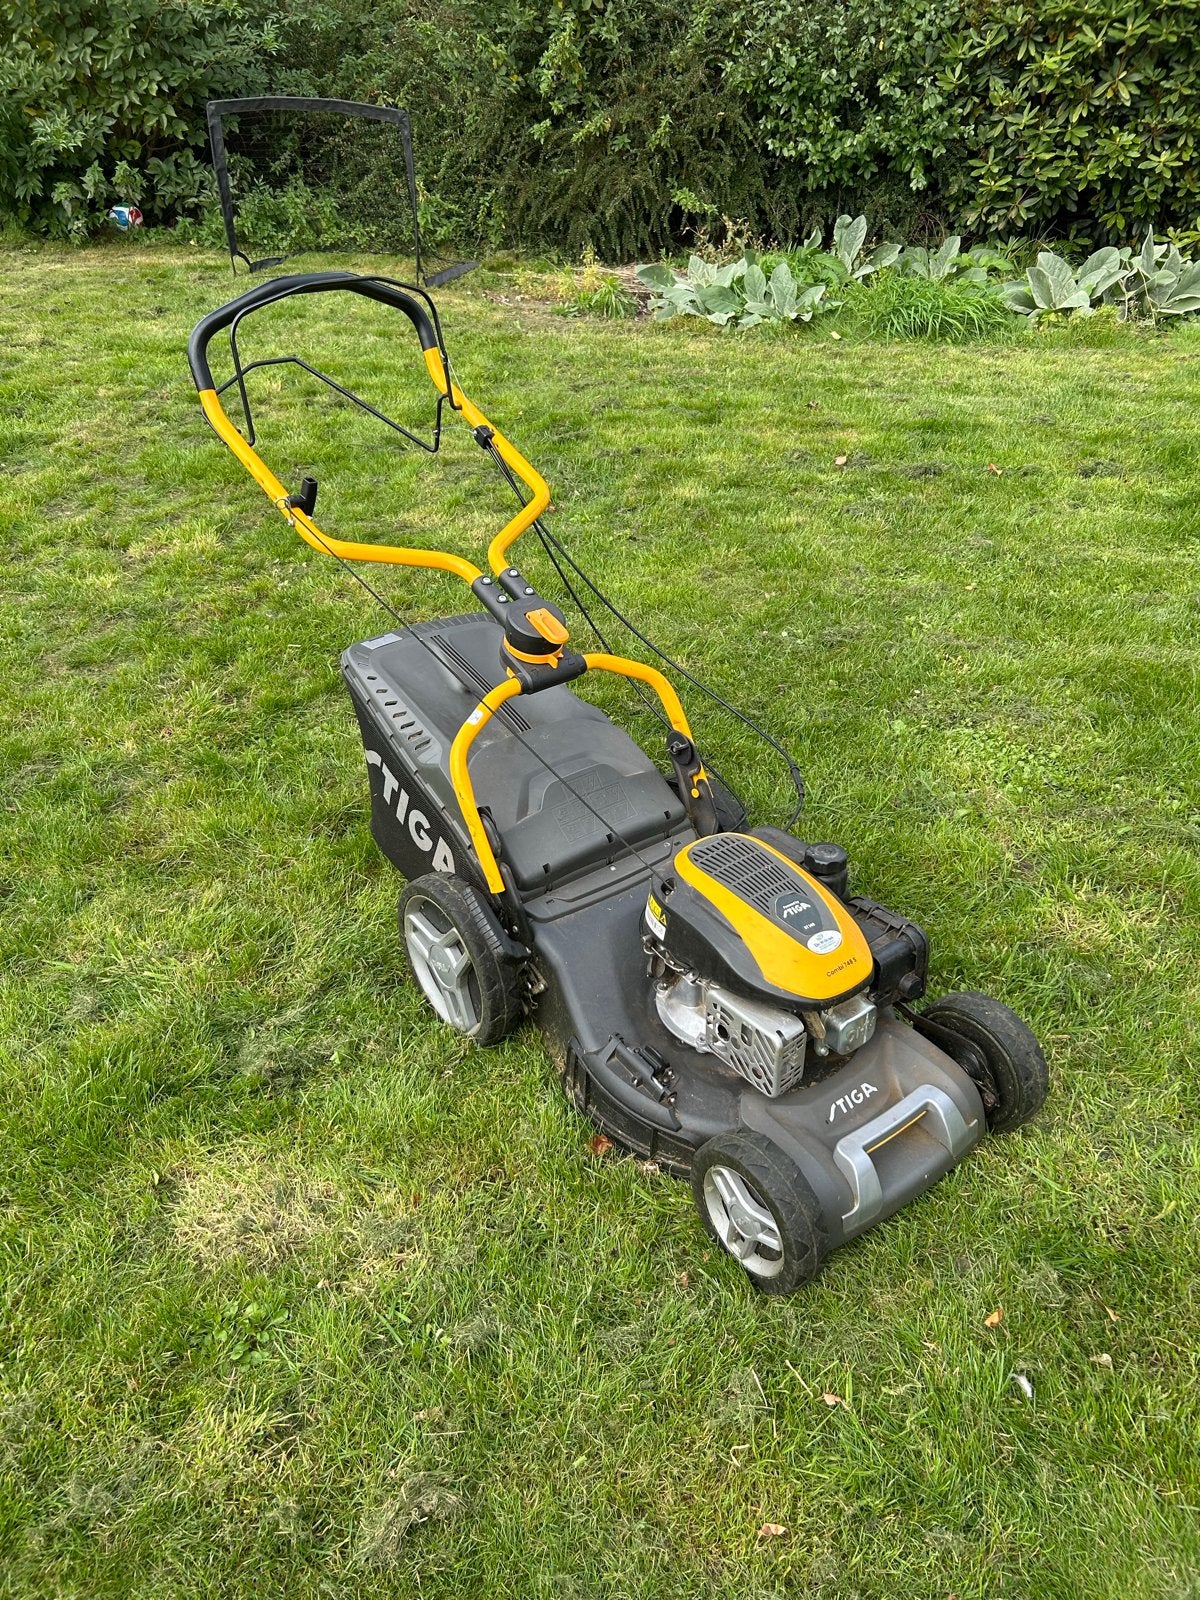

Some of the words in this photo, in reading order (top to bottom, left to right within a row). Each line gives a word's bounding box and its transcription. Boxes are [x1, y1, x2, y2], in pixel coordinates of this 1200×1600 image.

[783, 903, 811, 918] STIGA
[826, 964, 844, 977] Combi
[829, 1082, 878, 1122] STIGA
